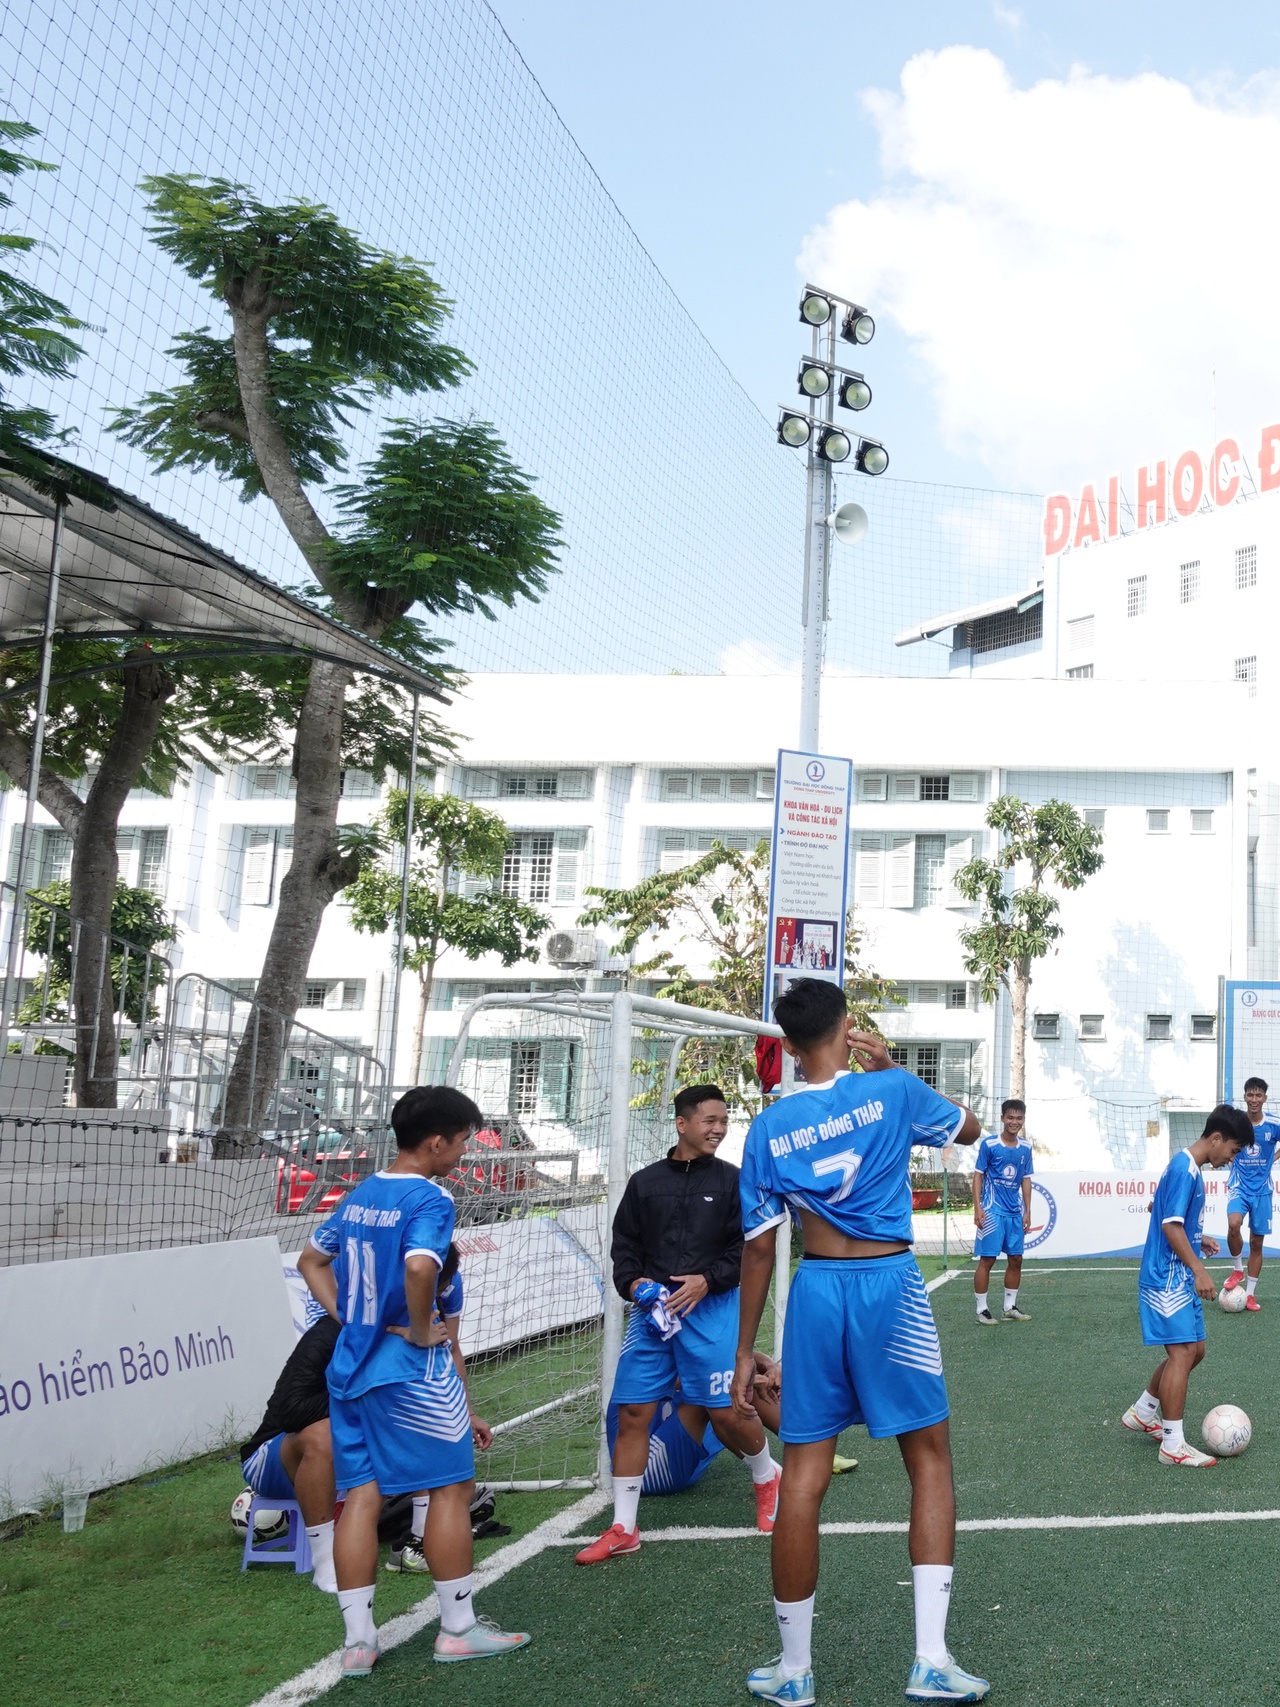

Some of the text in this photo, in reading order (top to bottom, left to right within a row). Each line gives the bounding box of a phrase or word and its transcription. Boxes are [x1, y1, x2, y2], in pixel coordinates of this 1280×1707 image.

[784, 800, 798, 809] KHOA
[787, 828, 810, 837] NGÀNH
[770, 1099, 884, 1158] ĐẠI HỌC ĐỒNG THÁP
[812, 1148, 862, 1204] 7
[1078, 1182, 1112, 1195] KHOA
[1116, 1178, 1145, 1195] GIÁO
[1024, 1222, 1054, 1250] NIVERSITY
[346, 1236, 377, 1326] 11
[38, 1349, 114, 1405] hiểm
[119, 1341, 169, 1385] Bảo
[174, 1325, 234, 1372] Minh
[710, 1371, 734, 1395] 28
